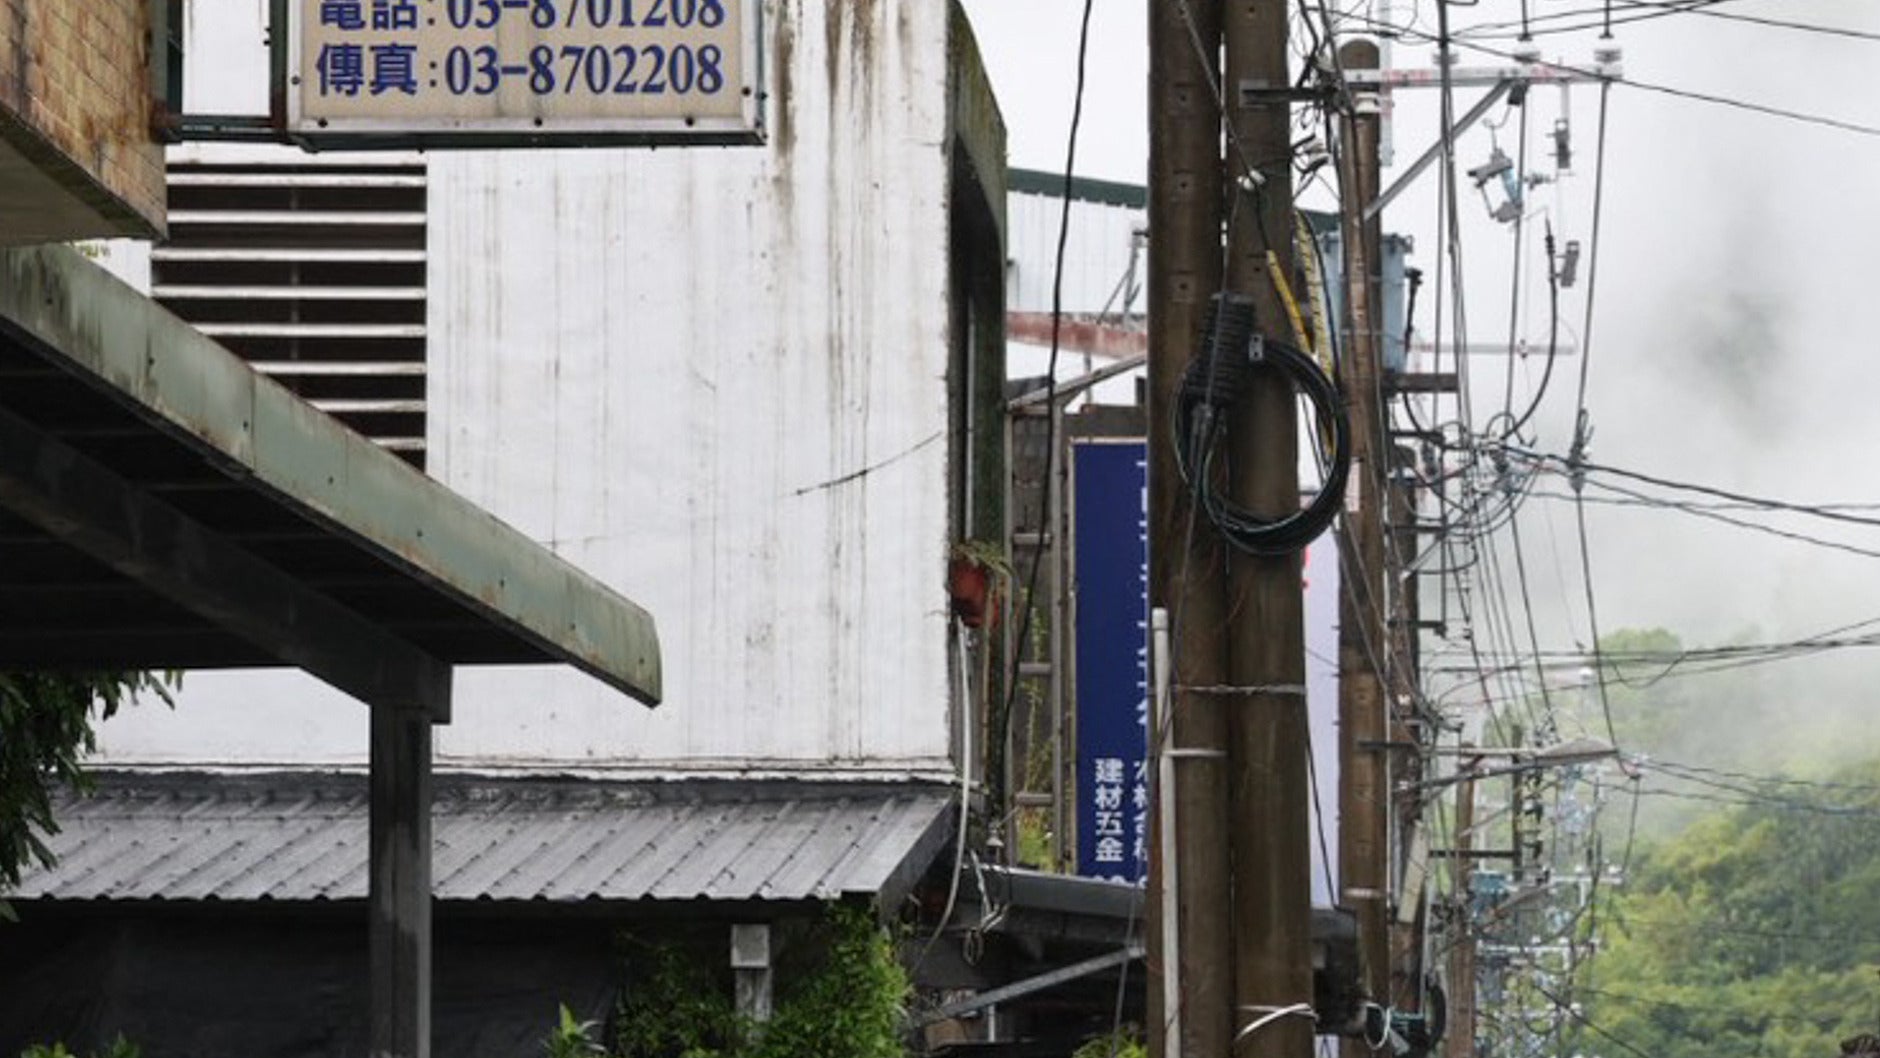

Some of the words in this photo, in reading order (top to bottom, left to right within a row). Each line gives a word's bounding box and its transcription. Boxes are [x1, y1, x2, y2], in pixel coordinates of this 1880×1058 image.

[316, 43, 724, 96] 傳真:03-8702208
[1095, 758, 1124, 862] 建材五金
